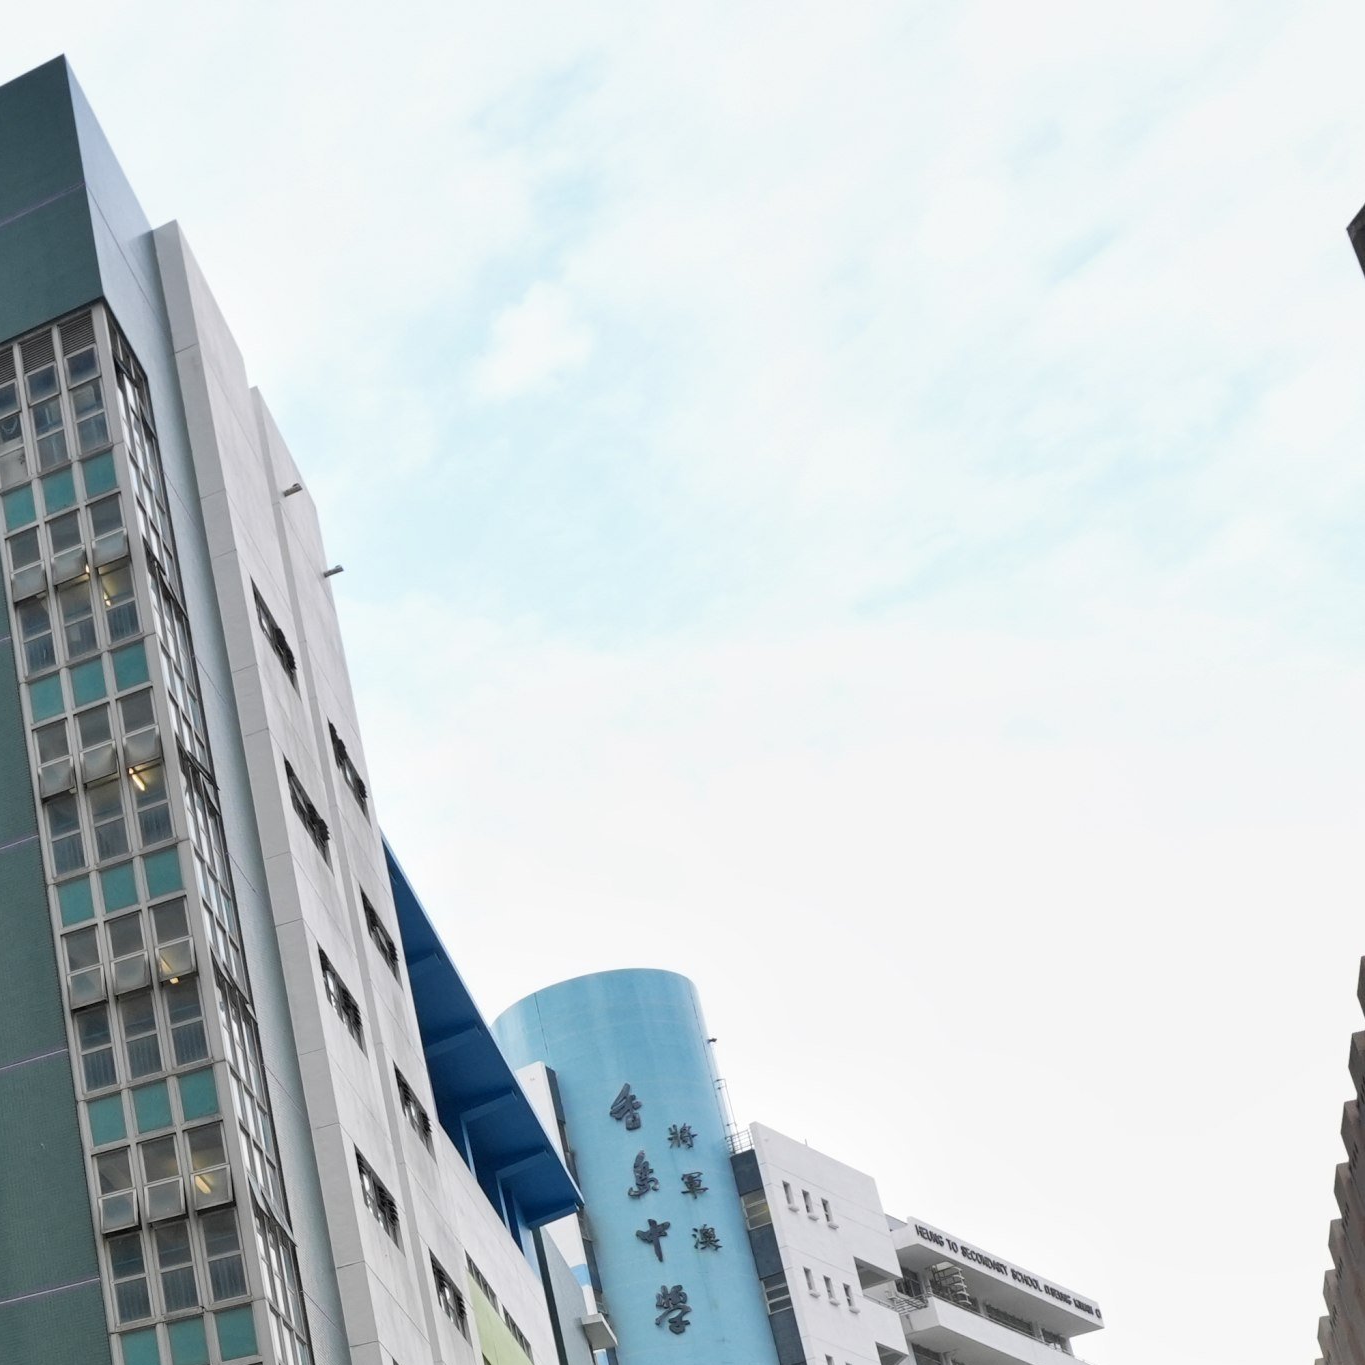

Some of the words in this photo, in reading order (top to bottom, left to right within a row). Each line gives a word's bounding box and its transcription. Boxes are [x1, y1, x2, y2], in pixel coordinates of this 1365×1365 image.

[609, 1082, 692, 1336] 香島中學
[667, 1122, 723, 1252] 將軍澳
[915, 1224, 945, 1247] HEUNG
[946, 1238, 959, 1254] TO
[1010, 1268, 1043, 1293] SCHOOL
